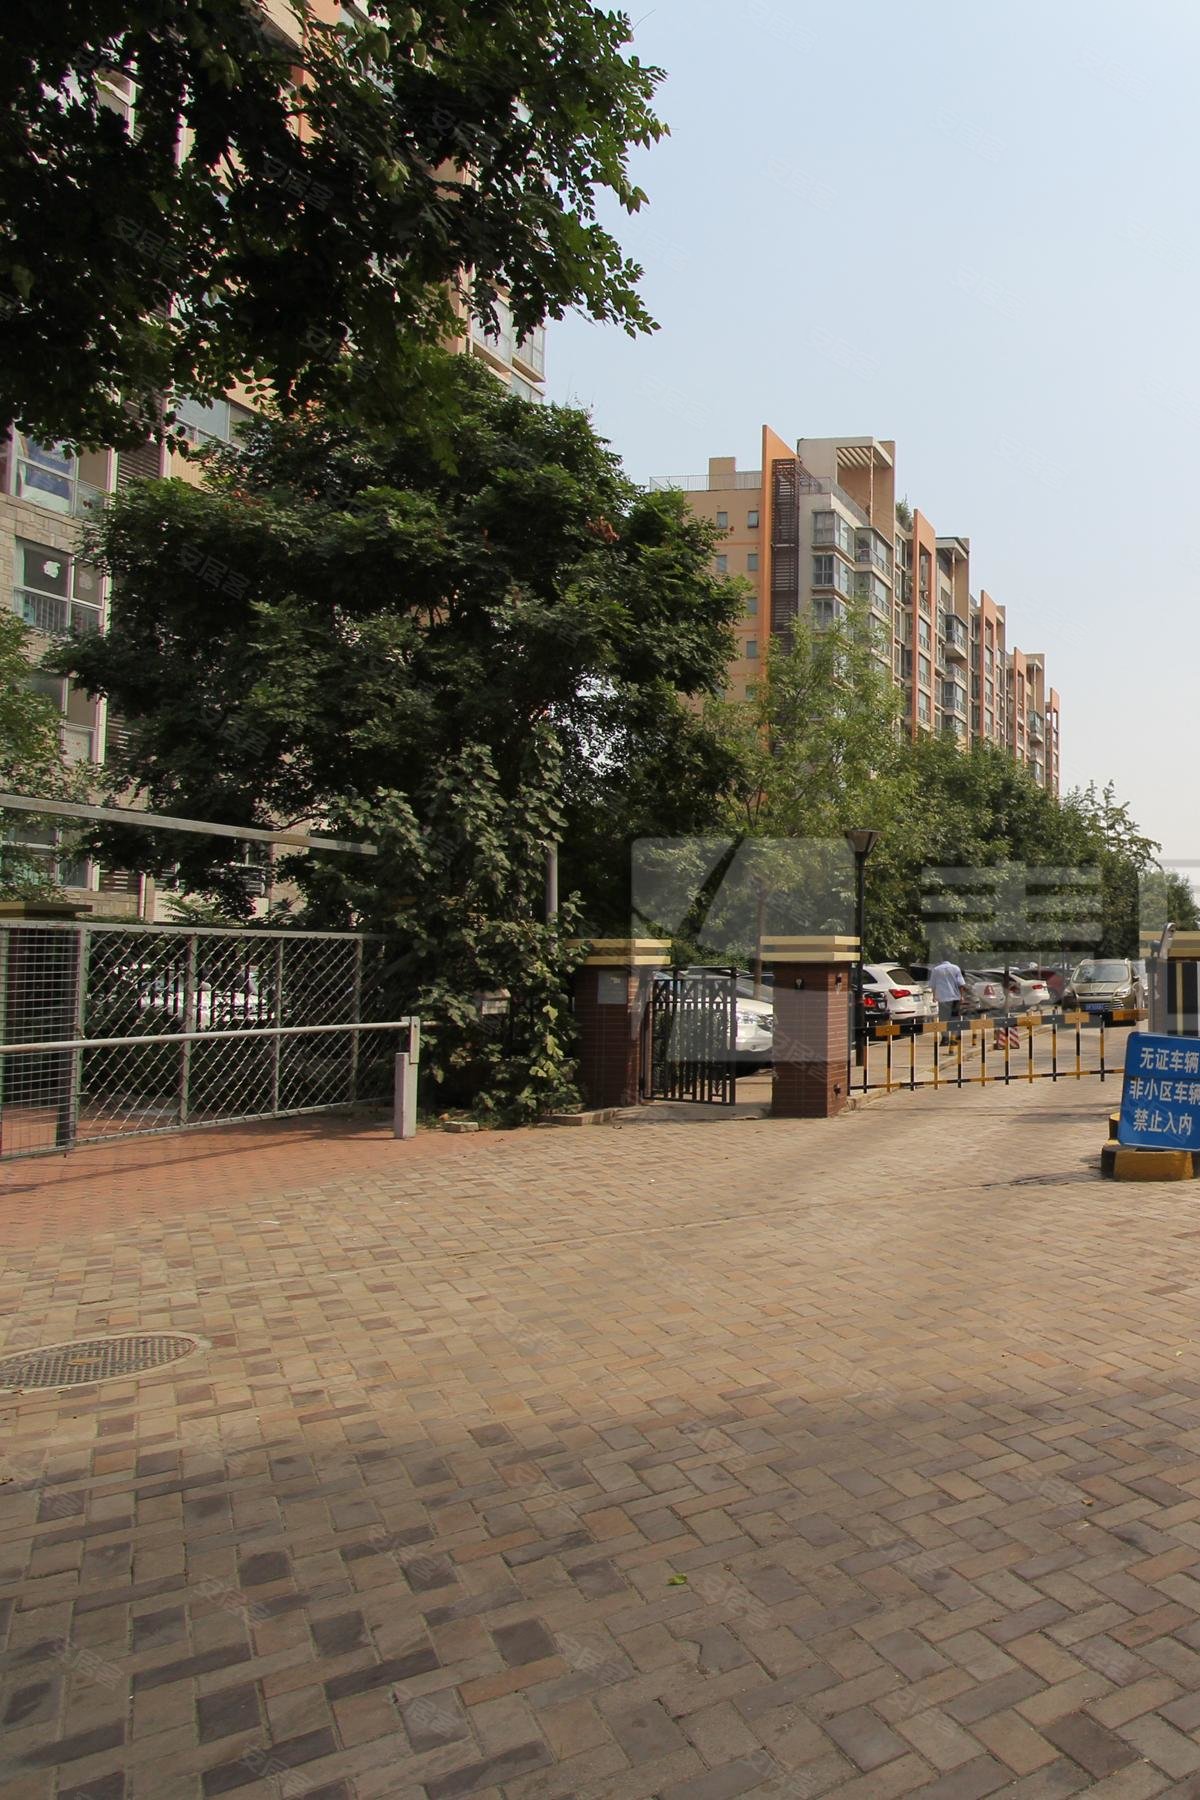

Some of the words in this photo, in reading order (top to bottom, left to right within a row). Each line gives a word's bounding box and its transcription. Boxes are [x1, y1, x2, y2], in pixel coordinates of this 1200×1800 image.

[1139, 1047, 1200, 1074] 无证车辆
[1132, 1108, 1193, 1136] 禁止入内
